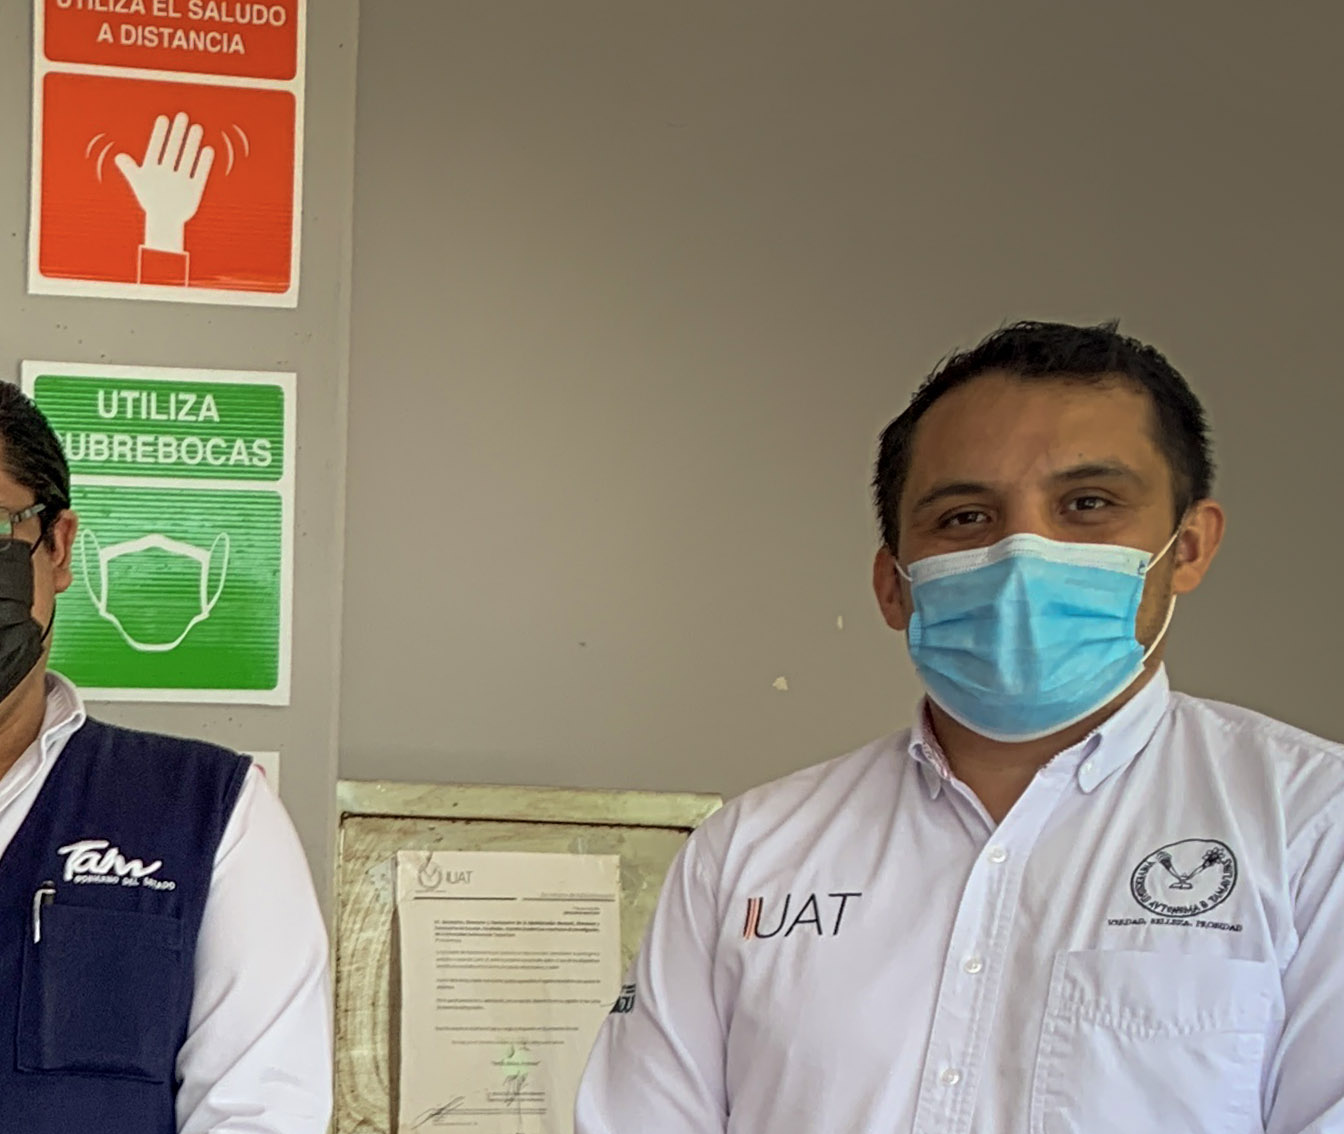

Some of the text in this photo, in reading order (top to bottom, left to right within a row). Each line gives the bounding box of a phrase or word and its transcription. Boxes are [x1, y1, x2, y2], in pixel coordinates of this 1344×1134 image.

[153, 0, 182, 18] EL
[188, 0, 287, 26] SALUDO
[96, 22, 246, 55] A DISTANCIA
[97, 389, 221, 422] UTILIZA
[58, 432, 273, 467] UBREBOCAS
